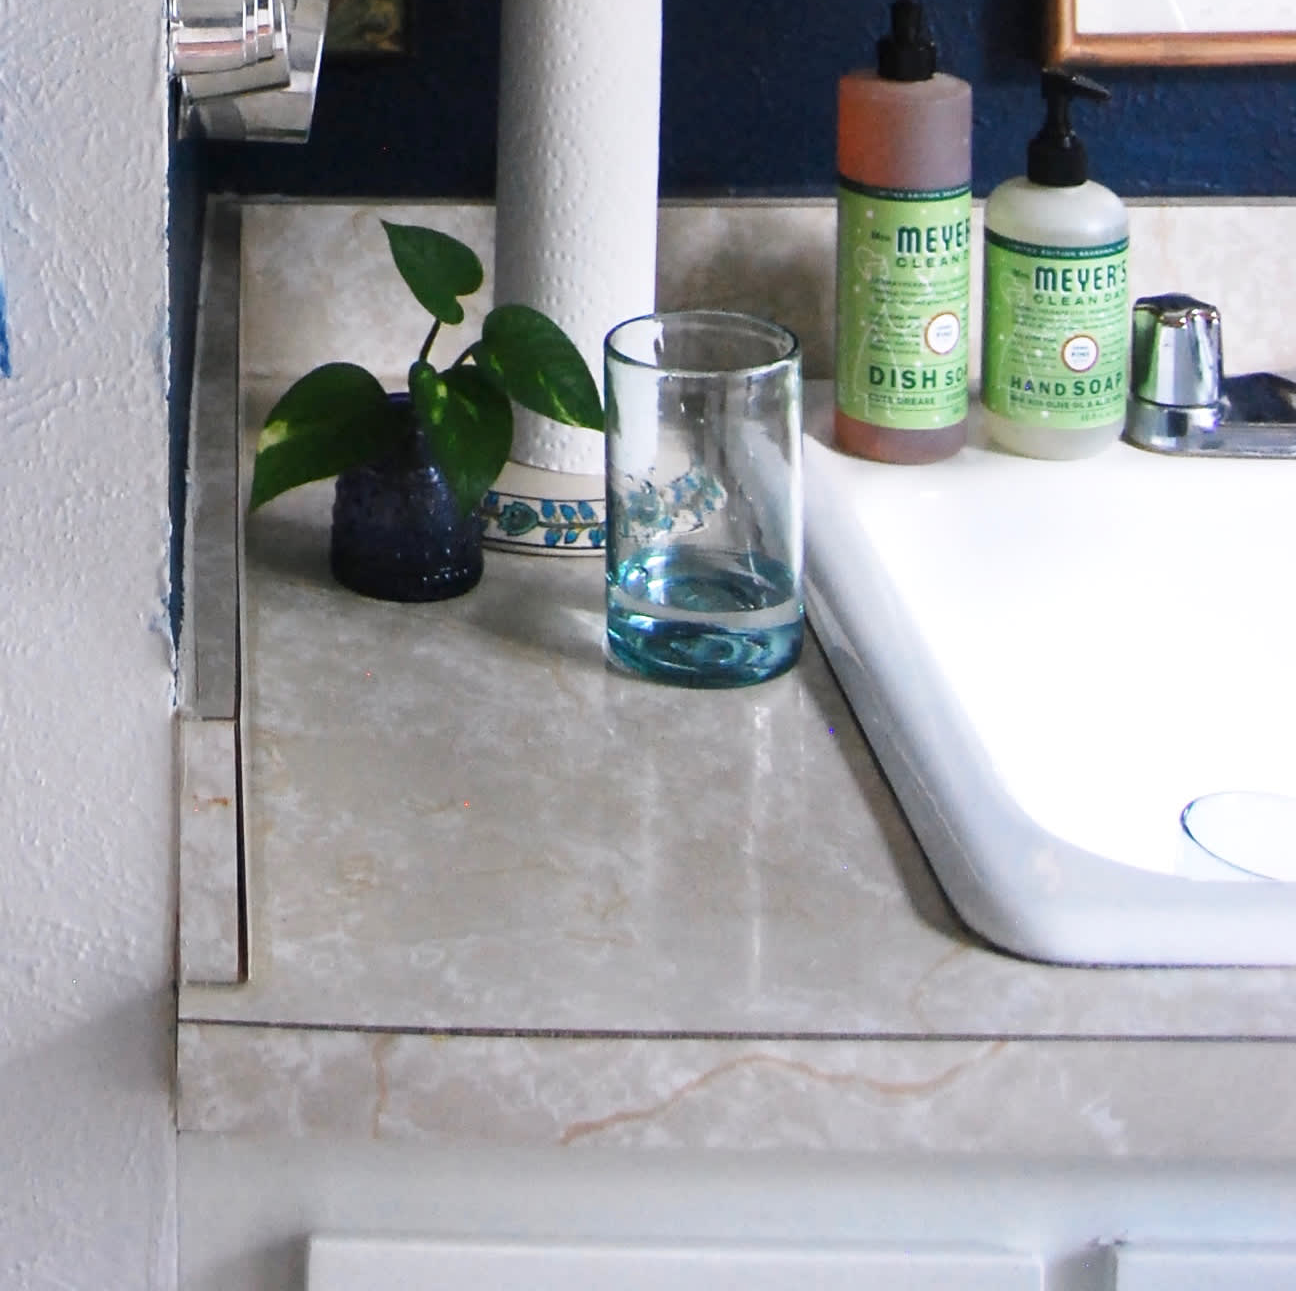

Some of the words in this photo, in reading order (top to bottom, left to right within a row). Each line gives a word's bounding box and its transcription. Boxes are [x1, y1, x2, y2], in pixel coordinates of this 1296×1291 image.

[1033, 294, 1098, 306] CLEAN
[869, 365, 937, 389] DISH
[1010, 375, 1067, 396] HAND
[1073, 372, 1123, 396] SOAP
